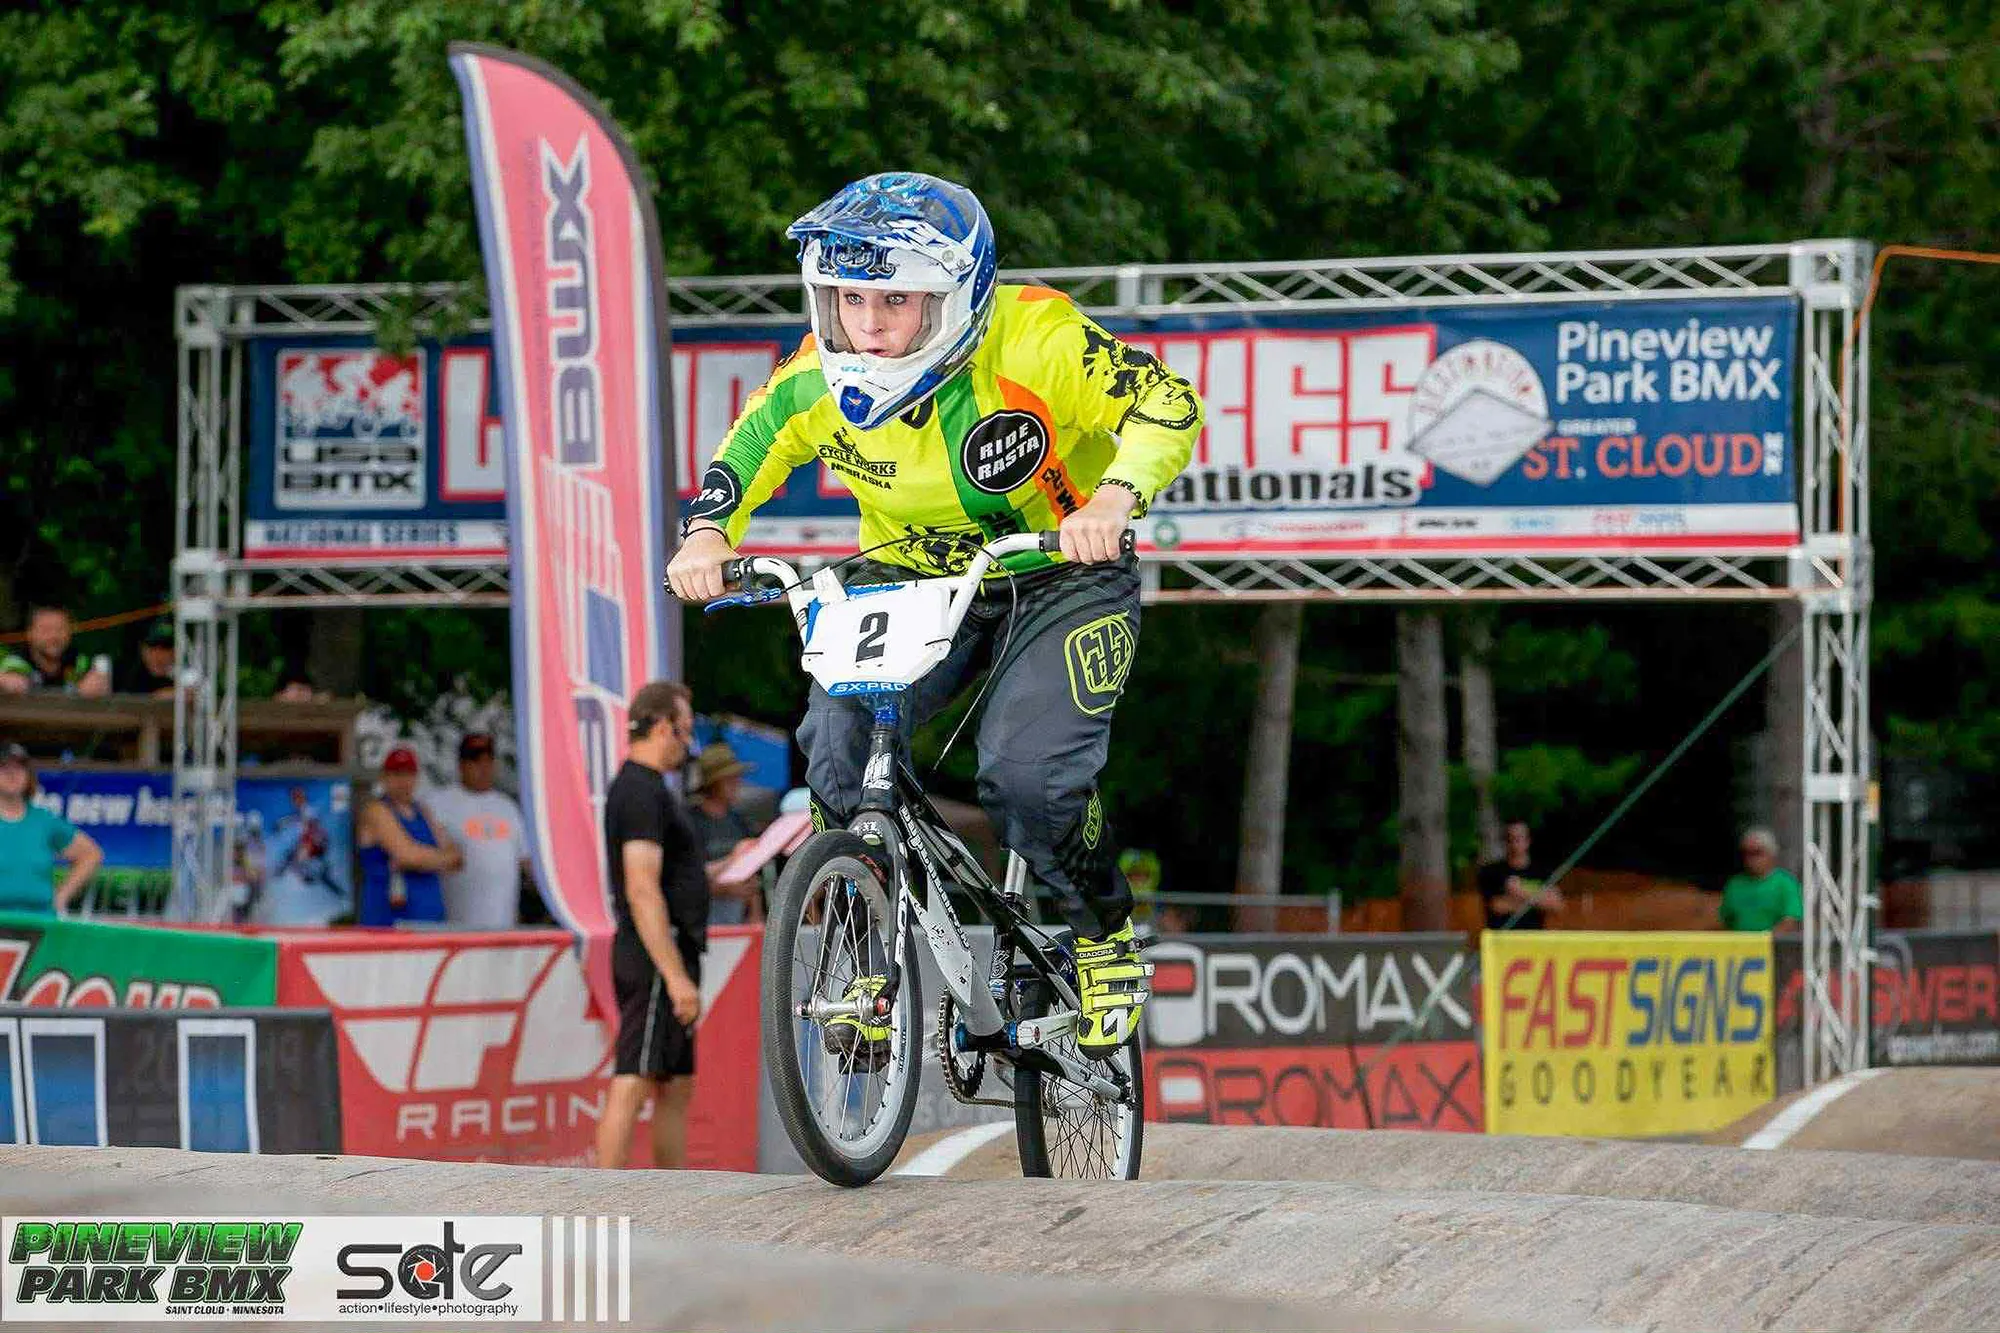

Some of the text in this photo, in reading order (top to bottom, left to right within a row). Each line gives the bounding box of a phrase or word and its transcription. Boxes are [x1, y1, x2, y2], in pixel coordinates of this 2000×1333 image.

[540, 133, 603, 469] BMX
[1557, 319, 1774, 362] Pineview
[1557, 361, 1660, 404] Park
[1669, 358, 1783, 402] BMX
[819, 447, 897, 475] CYCLE WORKS
[978, 436, 1040, 480] RASTA
[980, 422, 1029, 461] RIDE
[1522, 435, 1587, 480] ST.
[1596, 433, 1763, 478] CLOUD
[831, 462, 892, 490] NEBRASKA
[1162, 464, 1413, 502] ationals
[856, 611, 889, 663] 2
[834, 682, 907, 693] SX-PRO
[1079, 949, 1115, 959] DIADORA
[1143, 942, 1472, 1047] PROMAX
[1499, 1054, 1769, 1109] GOODYEAR
[397, 1092, 655, 1142] RACIN
